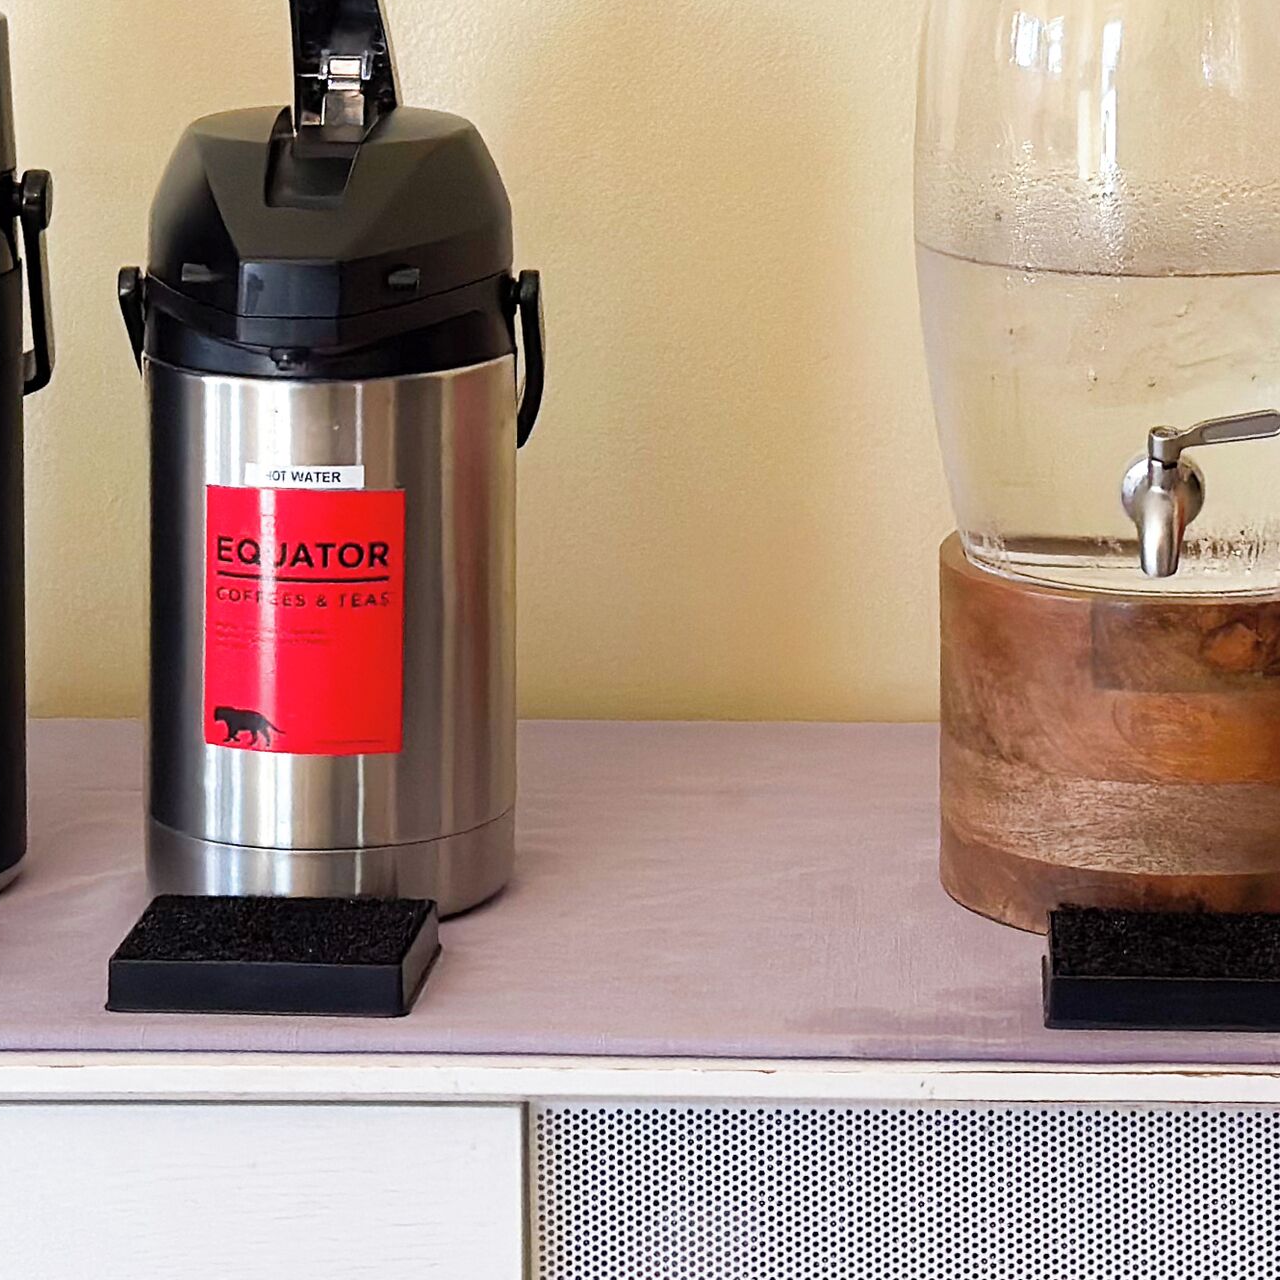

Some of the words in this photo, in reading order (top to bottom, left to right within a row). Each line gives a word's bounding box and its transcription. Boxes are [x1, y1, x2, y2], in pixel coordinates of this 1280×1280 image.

[291, 470, 342, 484] WATER
[315, 594, 328, 608] &
[339, 591, 391, 609] TEAS
